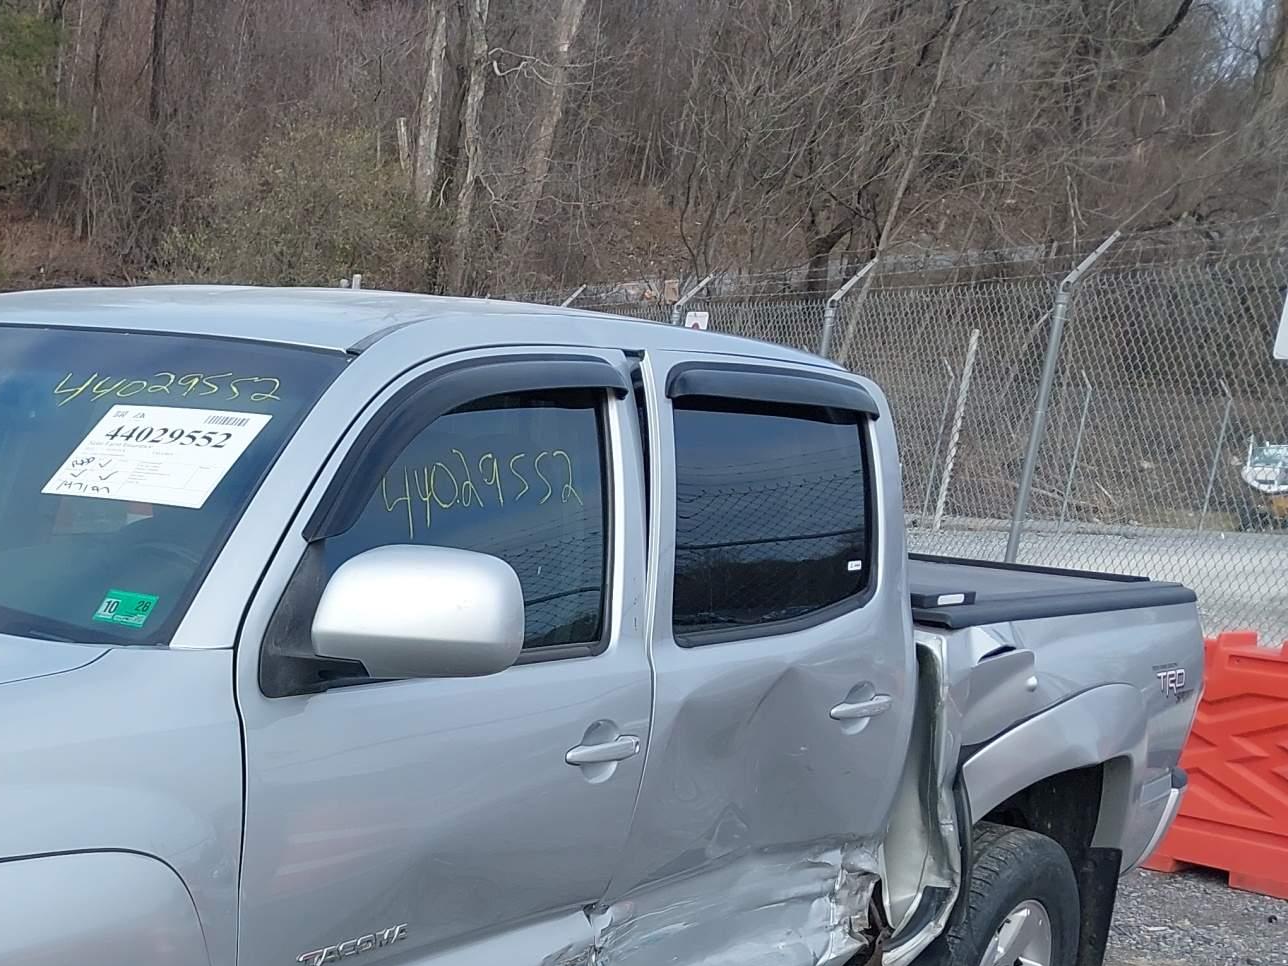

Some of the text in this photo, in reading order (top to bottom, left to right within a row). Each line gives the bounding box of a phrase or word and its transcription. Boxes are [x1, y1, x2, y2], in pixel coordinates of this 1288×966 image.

[53, 372, 281, 408] 44029552
[105, 424, 233, 449] 44029552
[382, 449, 584, 541] 44029552
[103, 600, 120, 614] 10
[1156, 668, 1186, 699] TRD
